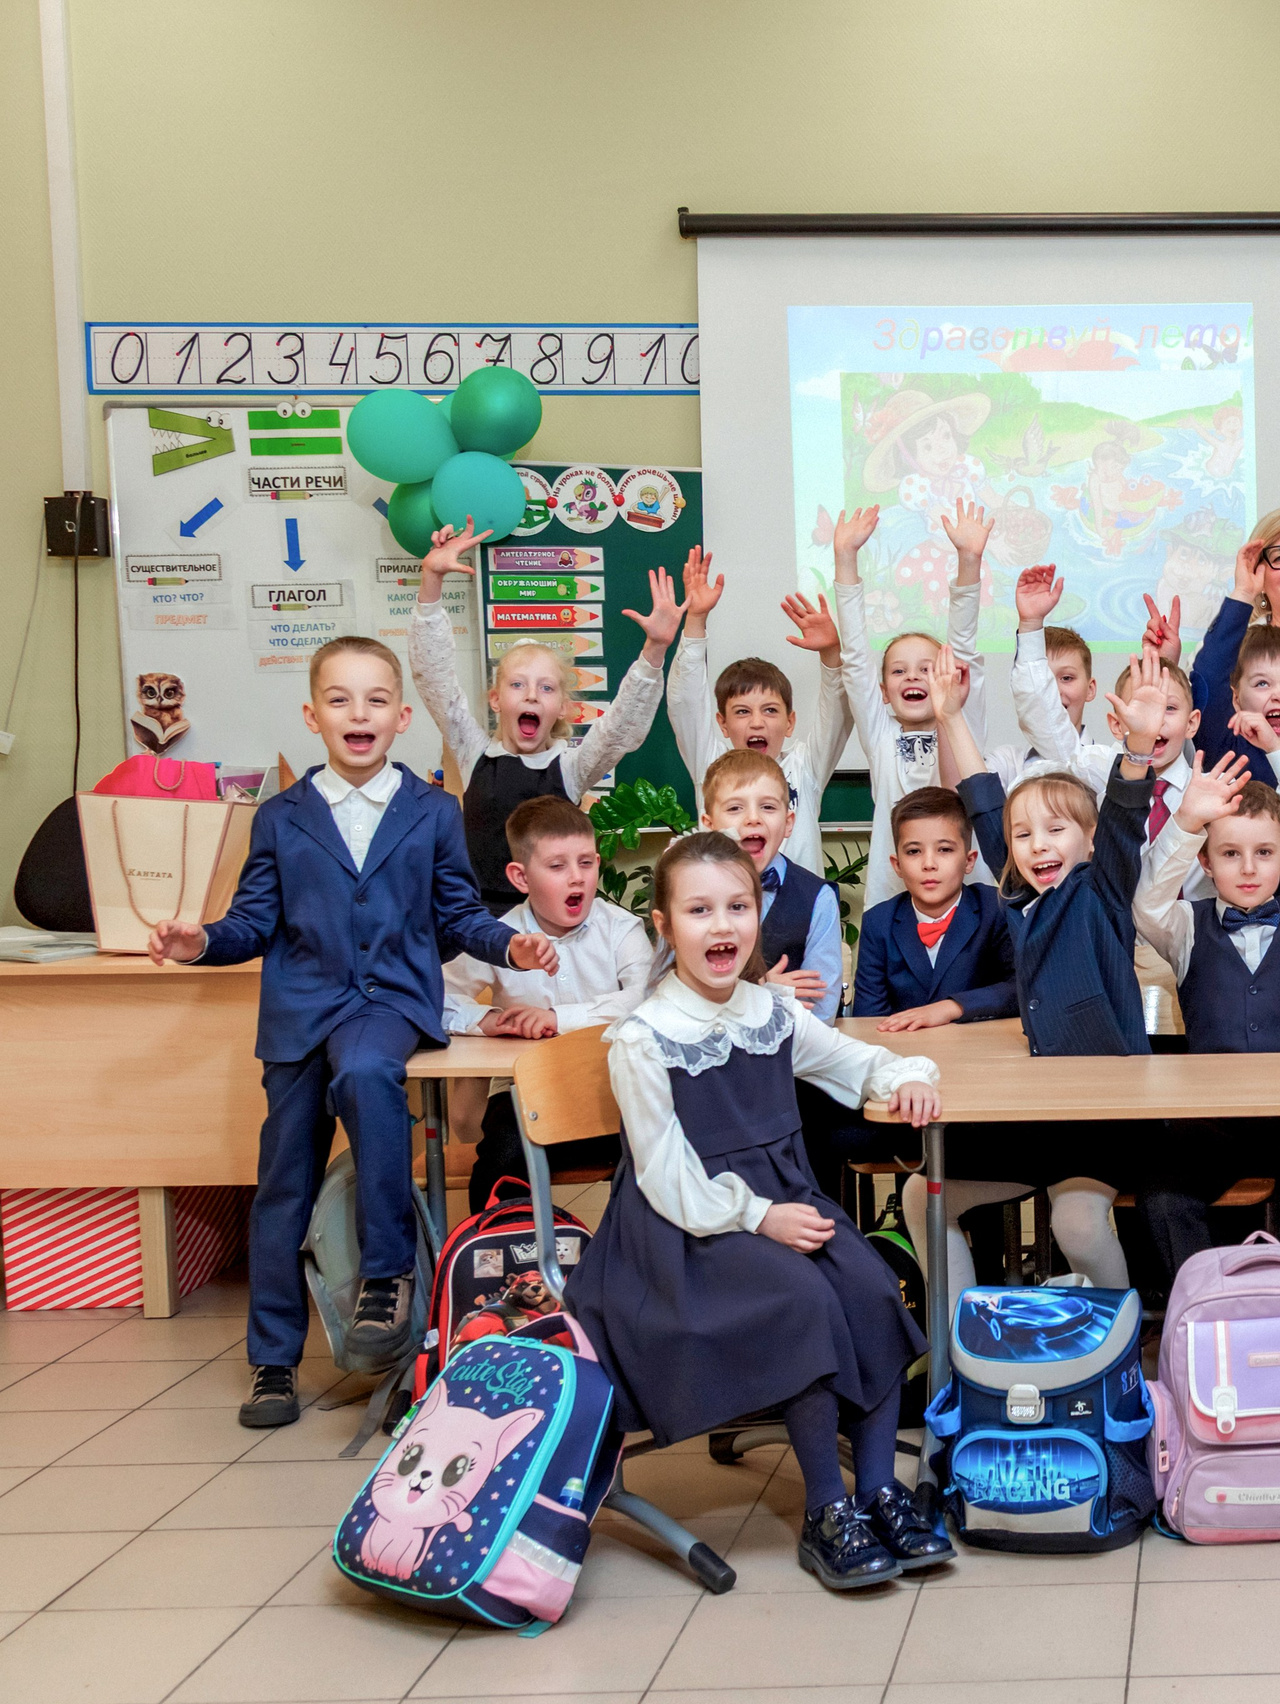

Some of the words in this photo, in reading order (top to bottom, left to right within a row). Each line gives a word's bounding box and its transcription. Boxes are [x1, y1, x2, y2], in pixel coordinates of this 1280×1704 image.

[111, 332, 144, 384] 0
[176, 332, 199, 384] 1
[216, 332, 251, 384] 2
[268, 332, 304, 384] 3
[329, 332, 355, 384] 4
[369, 333, 408, 384] 5
[423, 333, 458, 384] 6
[475, 333, 511, 366] 7
[530, 333, 562, 384] 8
[582, 333, 614, 384] 9
[640, 333, 699, 385] 10
[251, 476, 301, 489] ЧАСТИ
[305, 476, 344, 488] РЕЧИ
[553, 487, 561, 497] На
[558, 470, 583, 487] уроках
[130, 564, 217, 573] СУЩЕСТВИТЕЛЬНОЕ
[152, 594, 178, 604] КТО?
[179, 592, 204, 602] ЧТО?
[268, 589, 327, 603] ГЛАГОЛ
[155, 614, 208, 626] ПРЕДМЕТ
[271, 624, 290, 632] ЧТО
[292, 622, 336, 633] ДЕЛАТЬ?
[269, 638, 288, 646] ЧТО
[973, 1477, 1071, 1502] RACING
